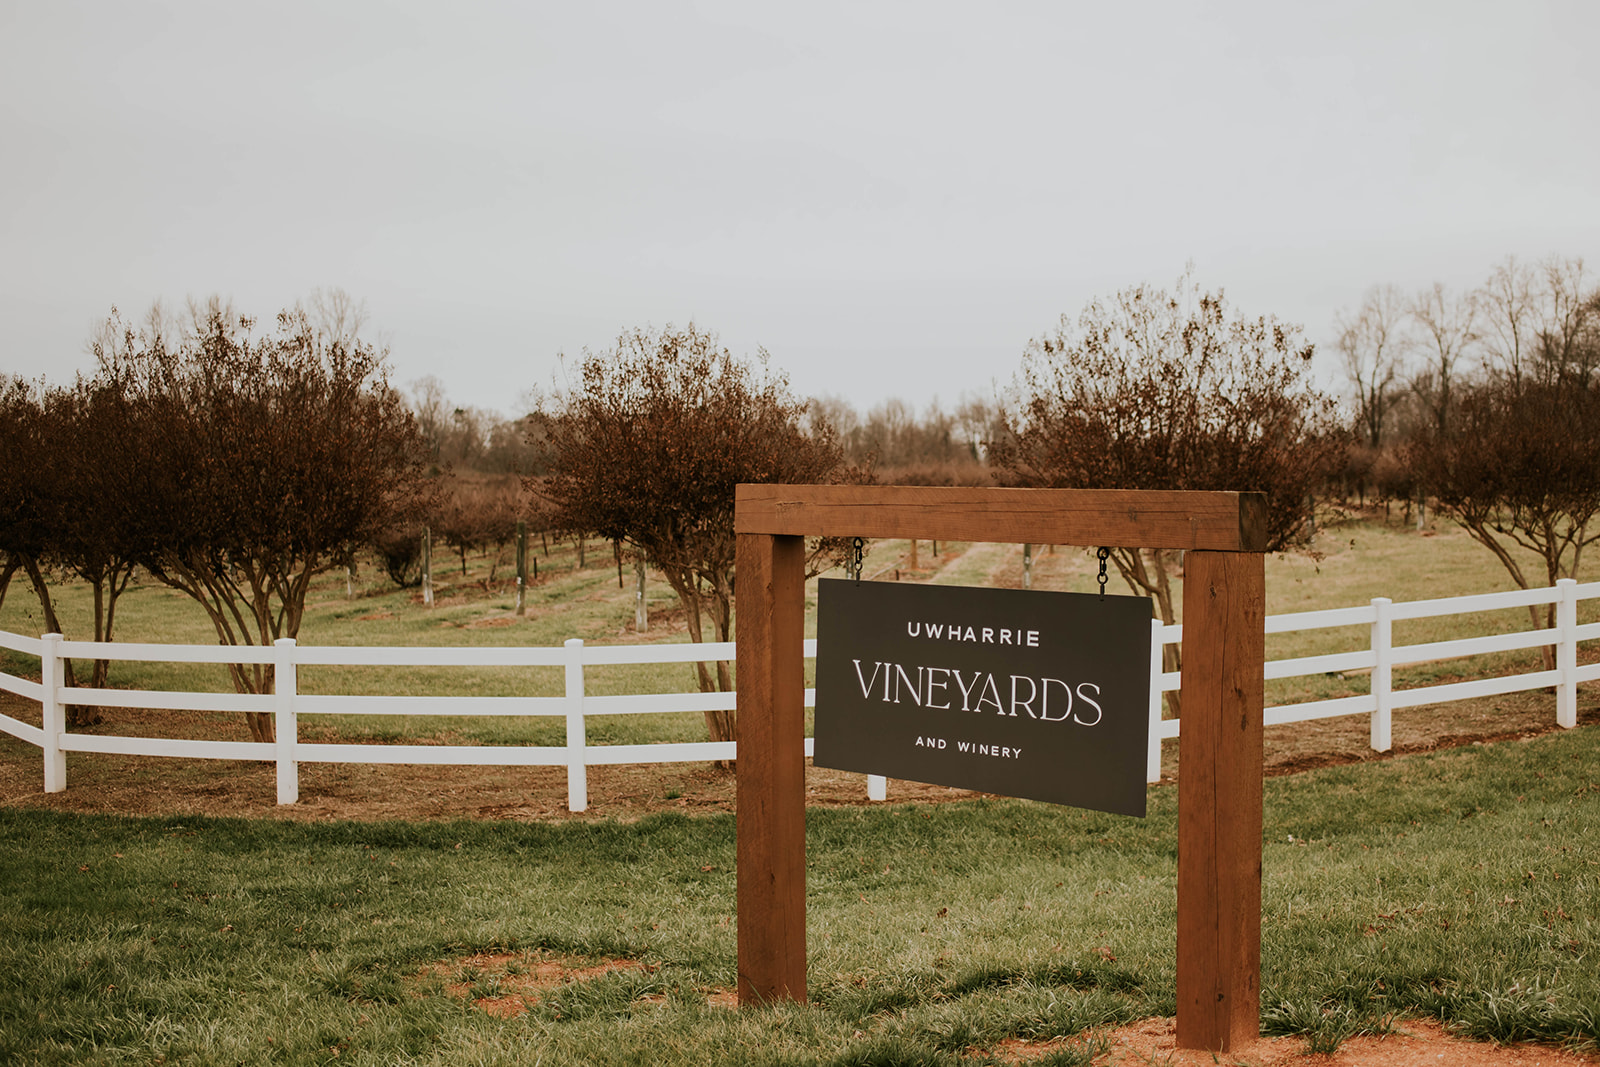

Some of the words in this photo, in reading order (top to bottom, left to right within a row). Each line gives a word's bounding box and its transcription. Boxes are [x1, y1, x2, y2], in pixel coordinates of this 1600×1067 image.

[907, 621, 1040, 647] UWHARRIE
[852, 659, 1103, 727] VINEYARDS
[915, 735, 947, 750] AND
[957, 740, 1022, 759] WINERY
